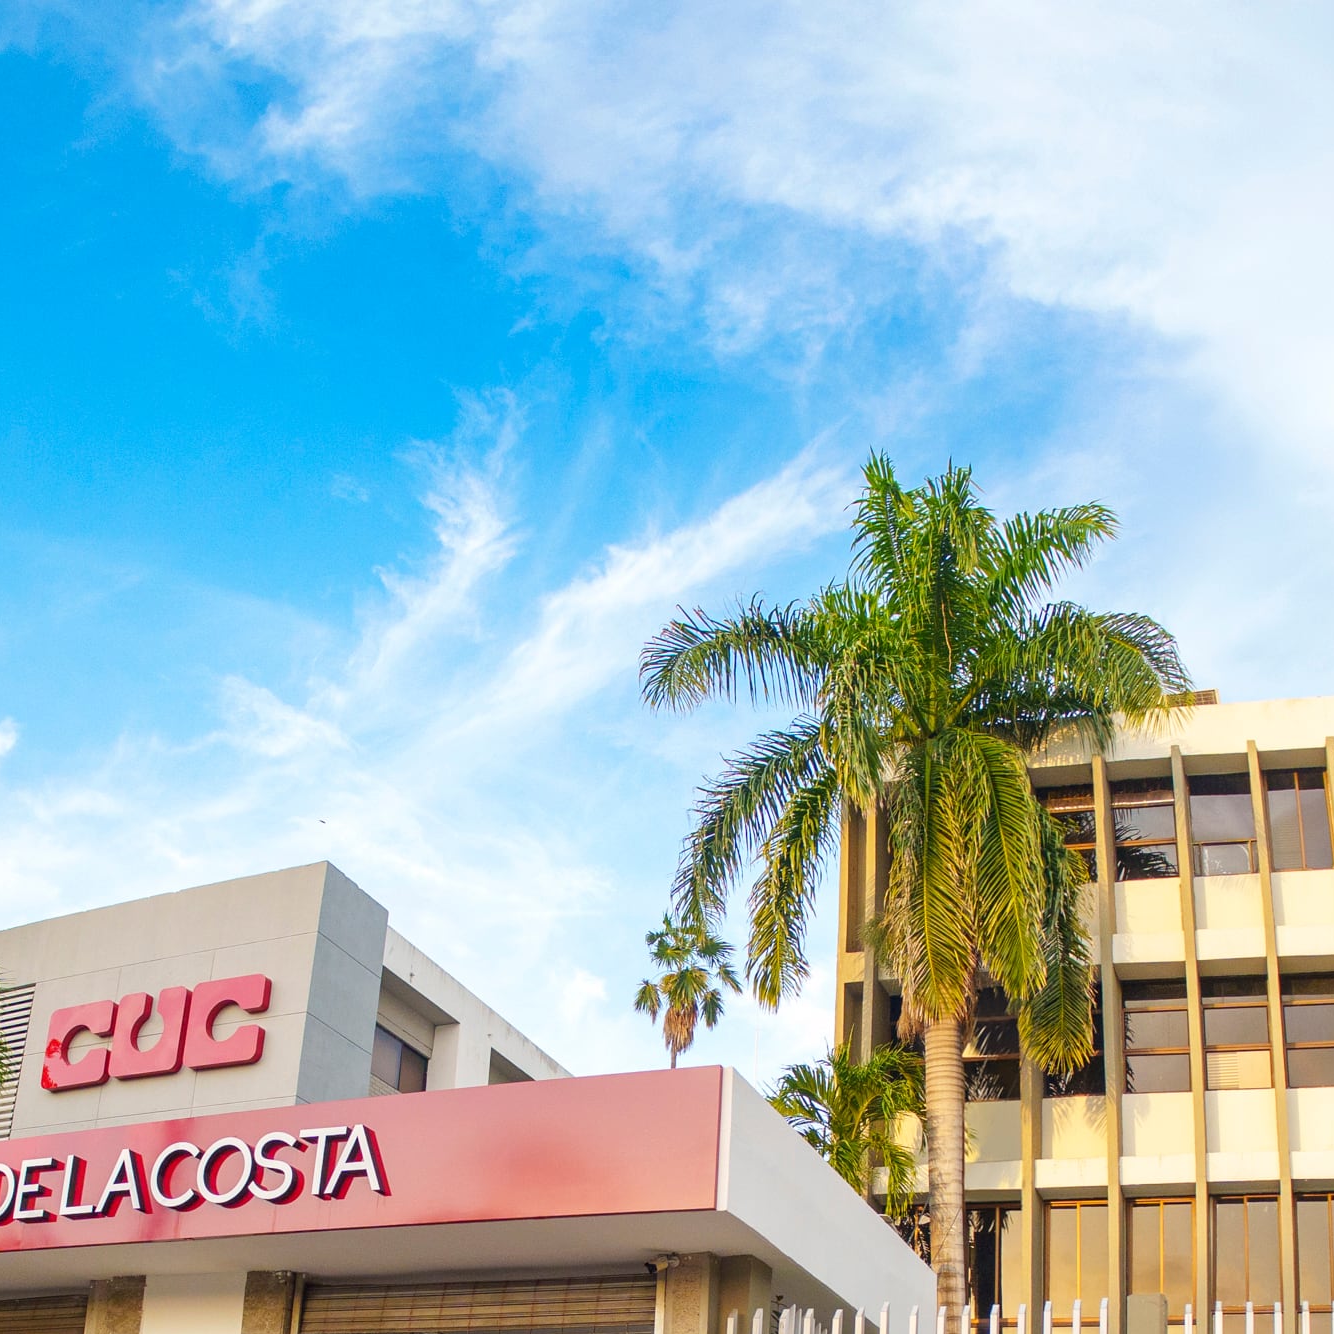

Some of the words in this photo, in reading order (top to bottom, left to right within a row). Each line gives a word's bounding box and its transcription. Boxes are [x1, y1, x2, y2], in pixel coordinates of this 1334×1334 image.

[41, 973, 272, 1092] CUC
[60, 1148, 141, 1216] LA
[150, 1123, 382, 1208] COSTA
